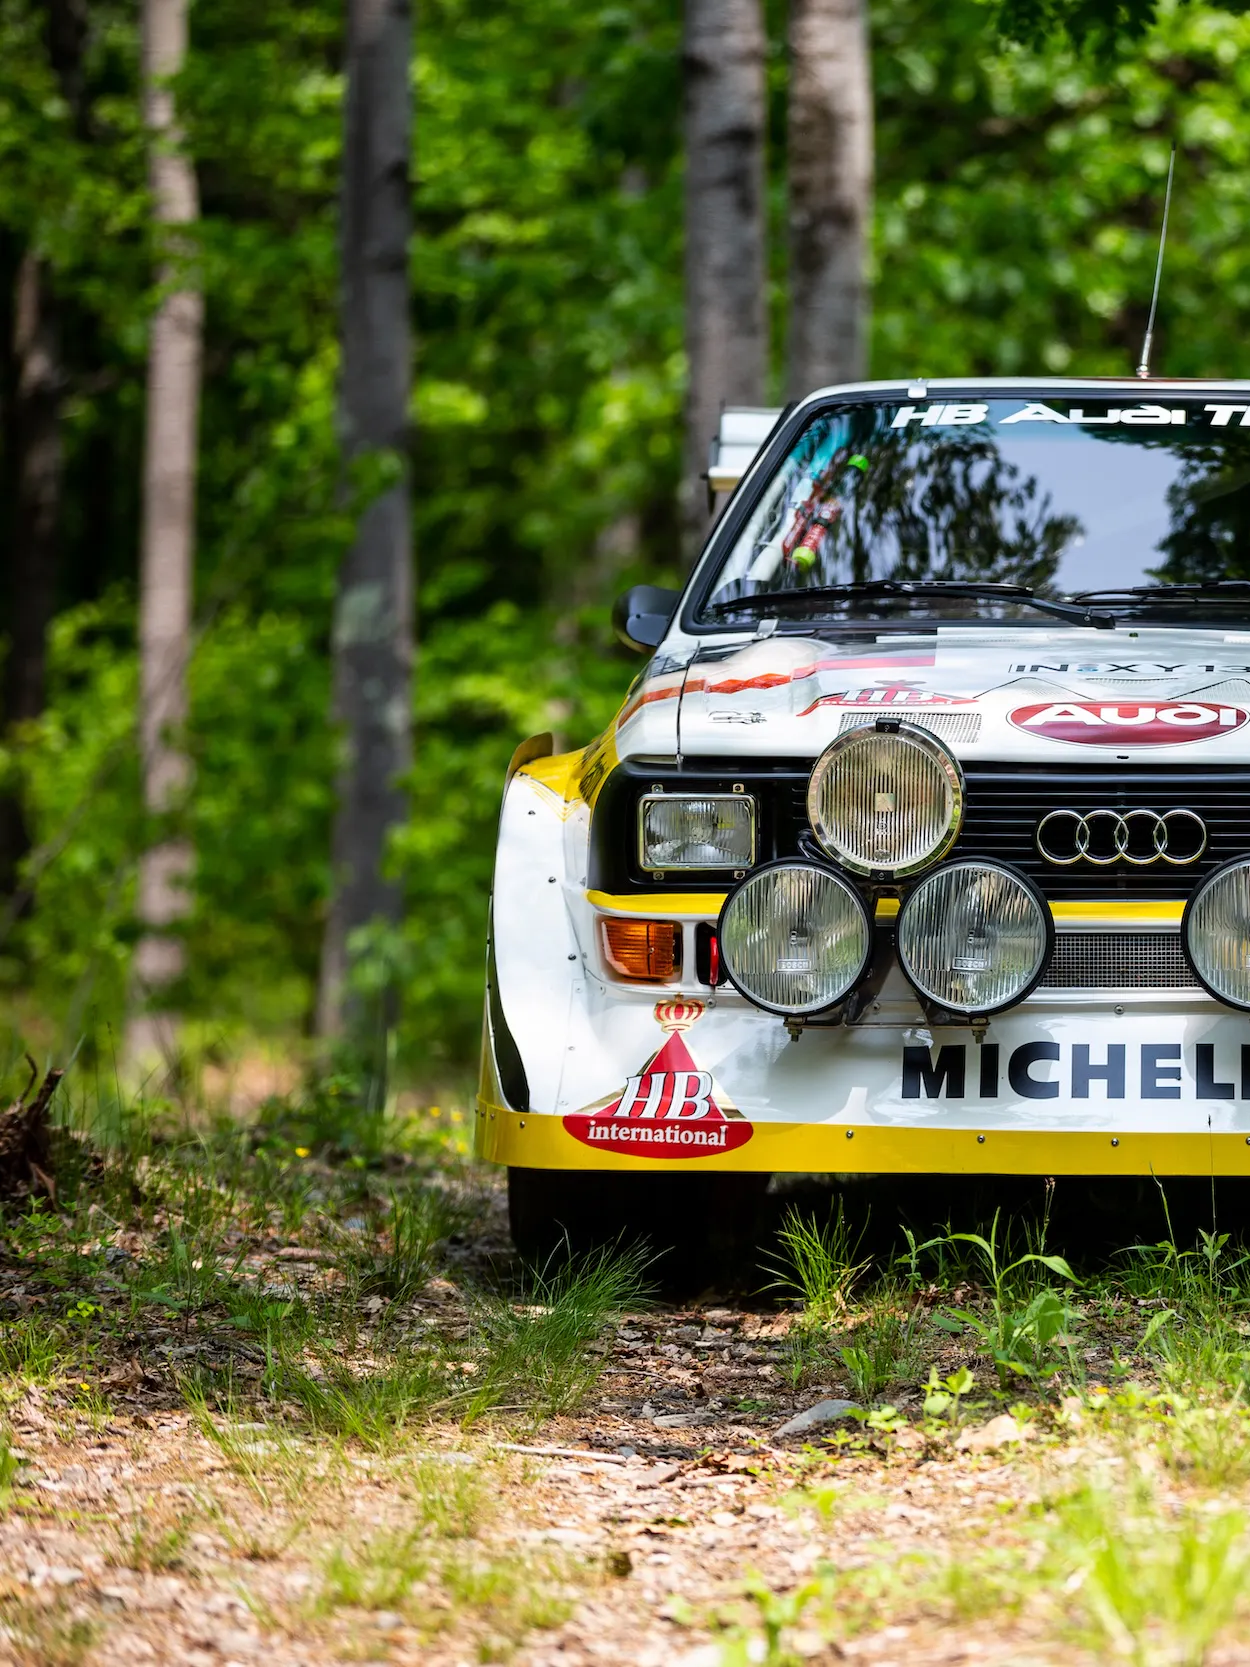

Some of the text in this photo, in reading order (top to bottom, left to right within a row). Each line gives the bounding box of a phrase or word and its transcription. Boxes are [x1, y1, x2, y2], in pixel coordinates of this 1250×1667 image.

[891, 403, 989, 429] HB
[999, 402, 1187, 426] Audi
[1020, 702, 1238, 727] Audi
[612, 1070, 714, 1121] HB
[587, 1120, 730, 1147] international
